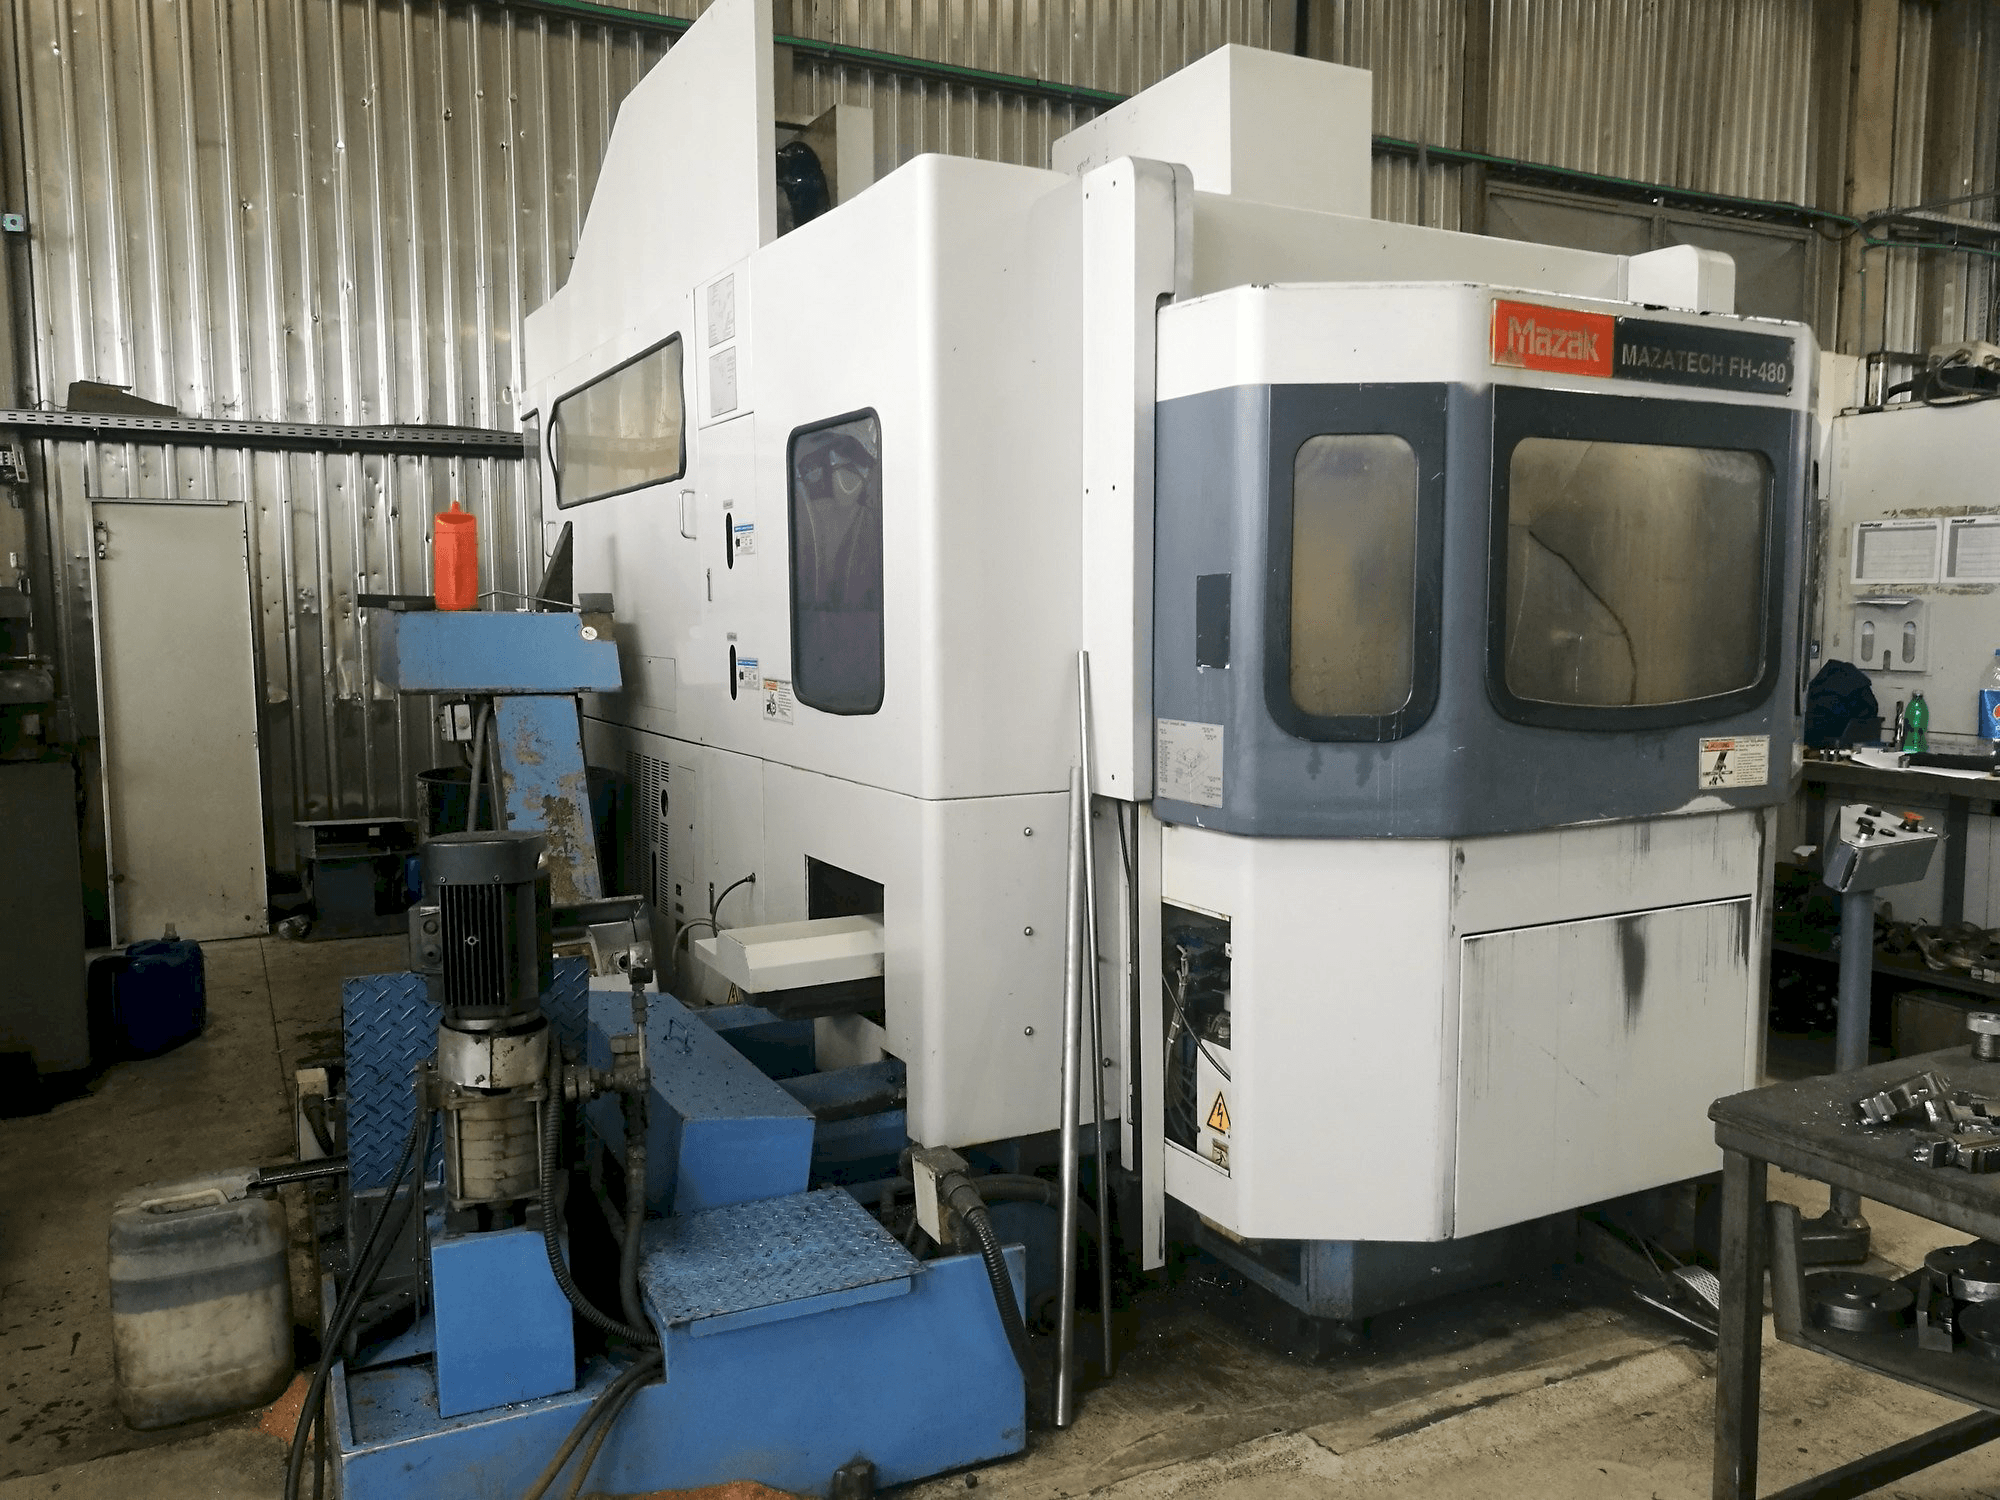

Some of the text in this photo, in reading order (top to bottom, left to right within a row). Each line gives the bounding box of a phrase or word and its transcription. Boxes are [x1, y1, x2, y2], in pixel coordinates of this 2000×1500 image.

[1508, 315, 1599, 362] Mazak
[1622, 343, 1786, 383] MAZATECH FH-480
